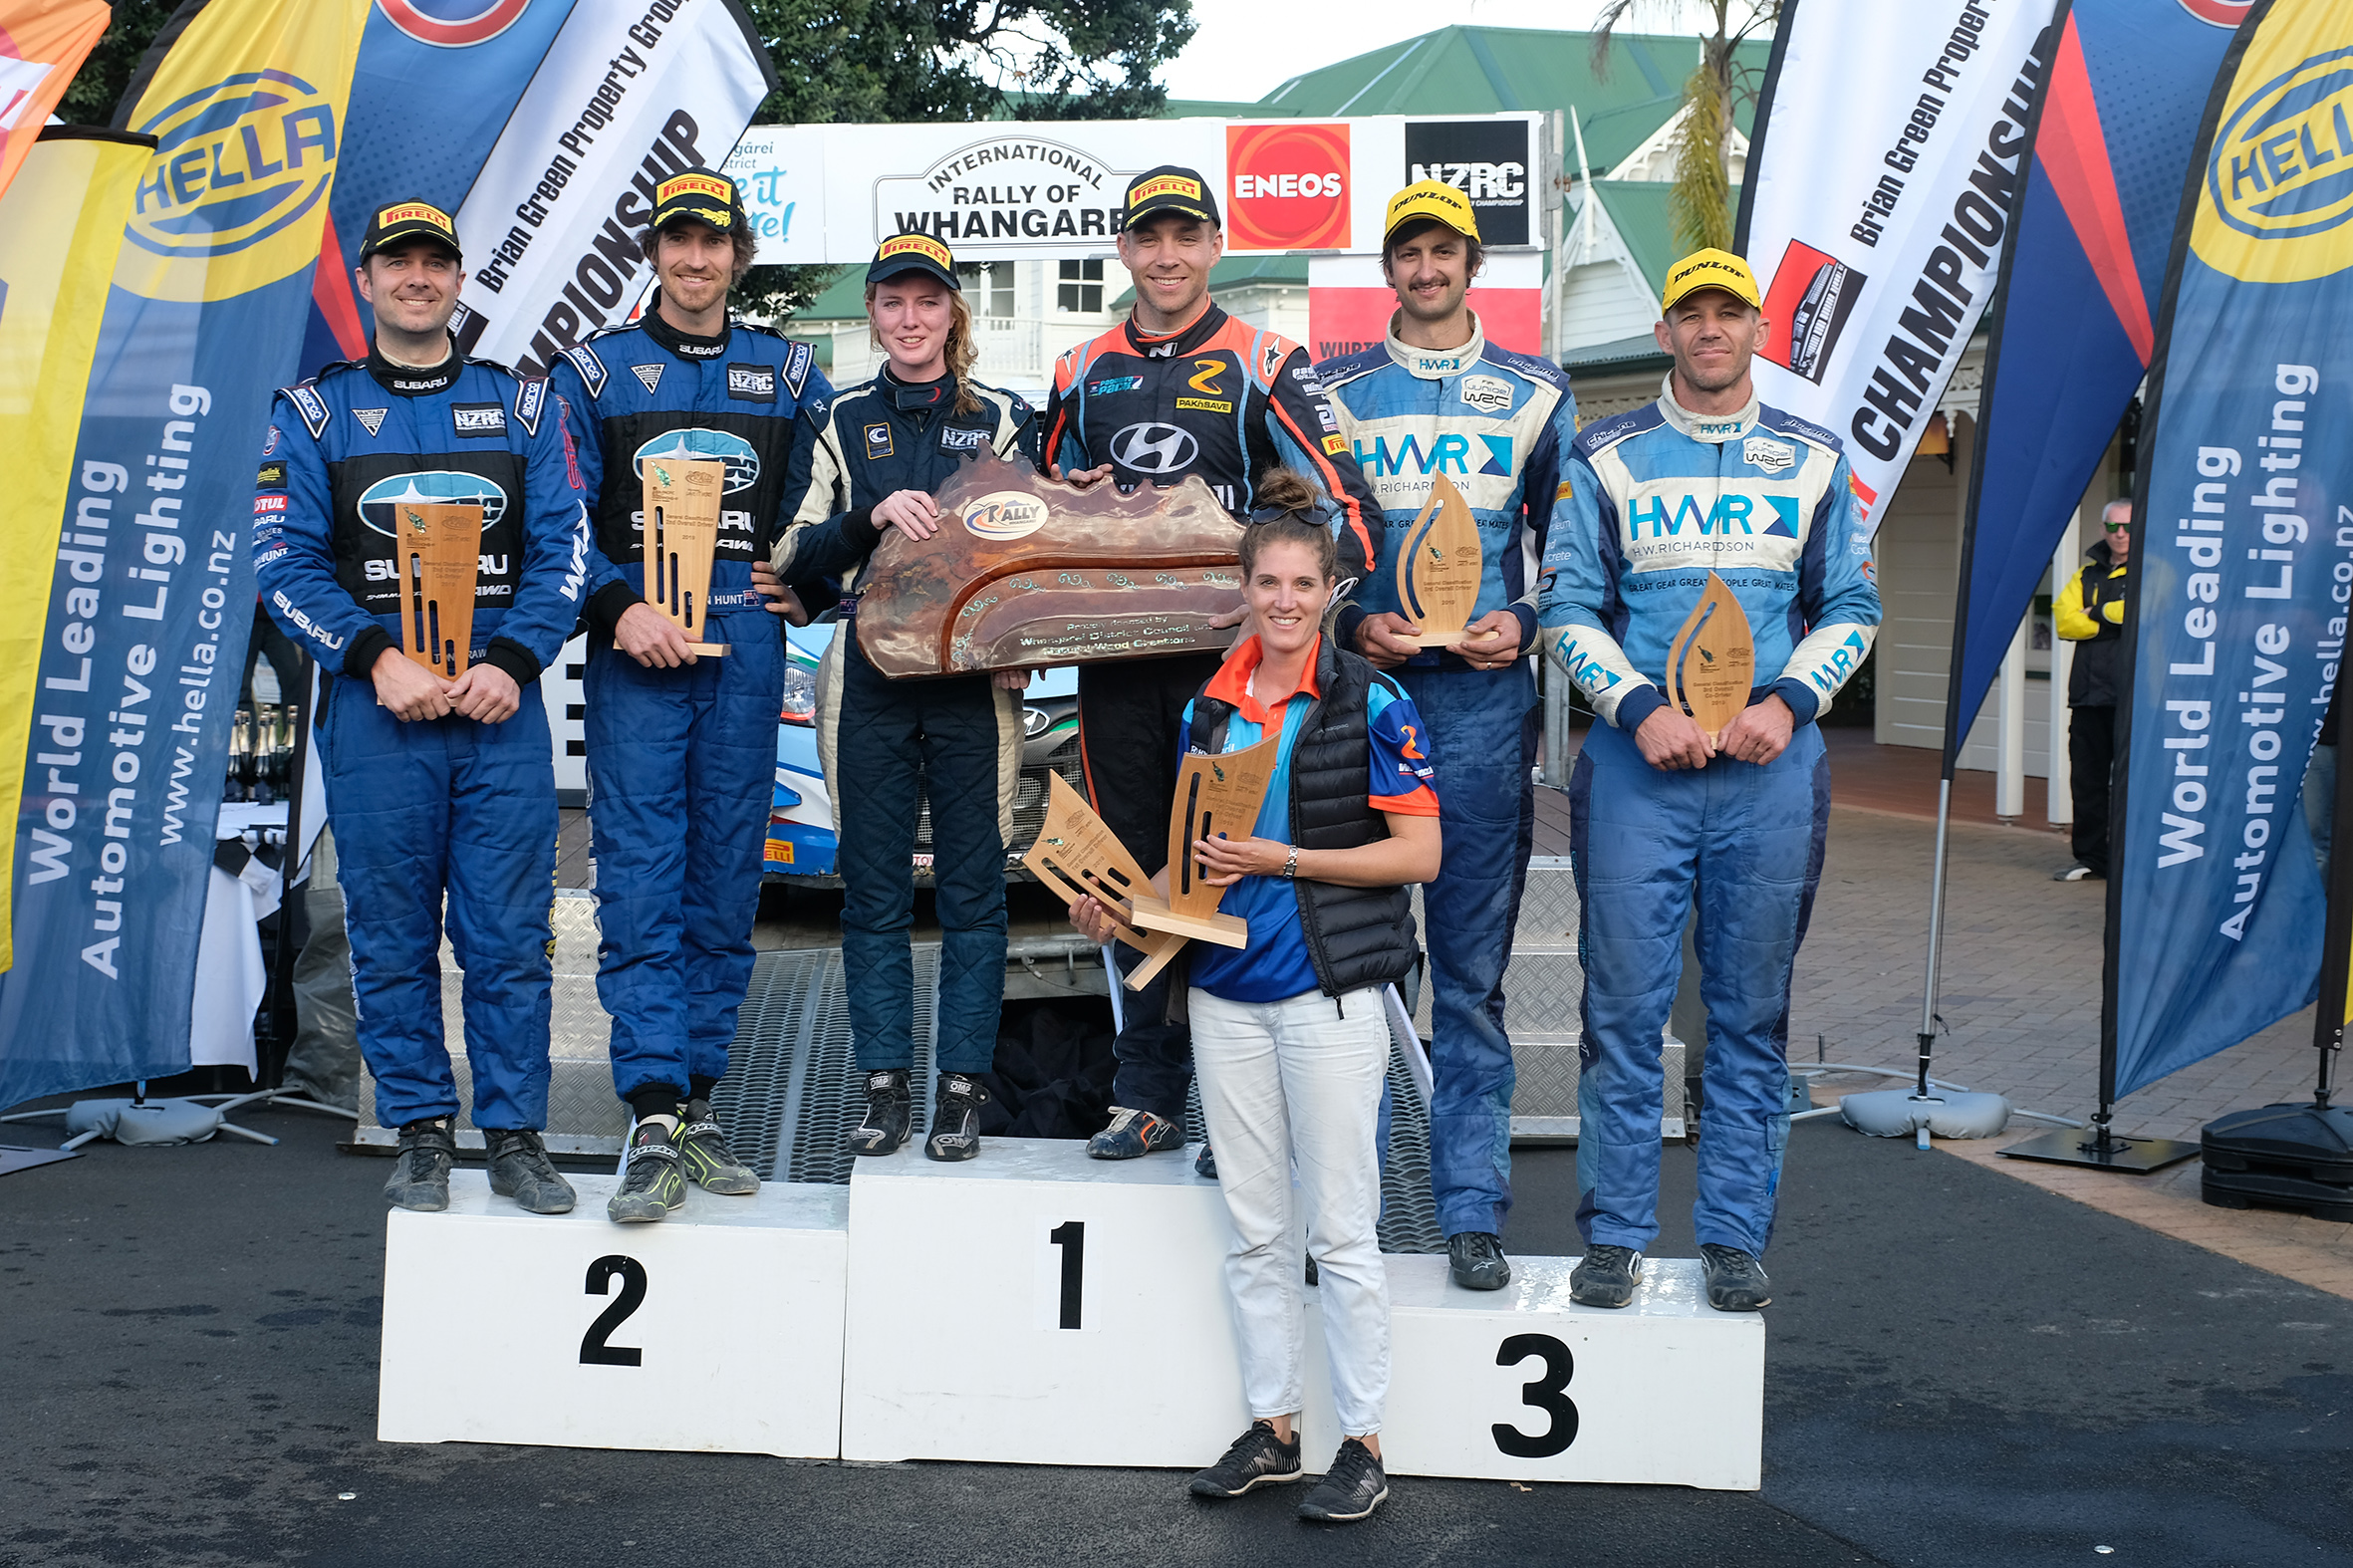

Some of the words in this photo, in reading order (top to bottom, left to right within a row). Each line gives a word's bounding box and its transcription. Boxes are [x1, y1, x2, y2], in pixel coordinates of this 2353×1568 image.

[1850, 174, 1905, 248] Brian
[1884, 93, 1946, 173] Green
[1922, 0, 1989, 94] Proper
[134, 103, 337, 215] HELLA
[475, 225, 533, 294] Brian
[516, 150, 577, 227] Green
[559, 46, 647, 157] Property
[629, 0, 689, 49] Grou
[734, 141, 773, 157] gārei
[2231, 102, 2353, 201] HELL
[723, 157, 757, 169] strict
[927, 144, 1103, 194] INTERNATIONAL
[662, 177, 725, 198] PIRELLI
[752, 165, 787, 207] it
[1134, 177, 1196, 201] PIRELLI
[1235, 172, 1343, 198] ENEOS
[1412, 161, 1524, 198] NZRC
[953, 185, 1037, 205] RALLY
[1046, 184, 1081, 204] OF
[1393, 191, 1462, 214] DUNLOP
[386, 206, 447, 229] PIRELLI
[752, 201, 796, 242] re!
[894, 208, 1124, 238] WHANGARE
[883, 240, 947, 265] PIRELLI
[1674, 261, 1745, 286] DUNLOP
[679, 344, 724, 356] SUBARU
[790, 345, 808, 381] sparco
[1420, 359, 1449, 370] HWR
[393, 376, 448, 391] SUBARU
[728, 373, 774, 392] NZRC
[1464, 392, 1509, 407] WRC
[454, 410, 505, 426] NZRC
[1700, 422, 1733, 434] HWR
[1354, 433, 1469, 477] HWR
[1746, 453, 1792, 466] WRC
[2244, 364, 2320, 600] Lighting
[254, 497, 285, 512] OTUL
[1628, 494, 1753, 541] HWR
[1488, 520, 1509, 530] MATES
[364, 554, 508, 582] SURU
[2169, 446, 2242, 676] Leading
[45, 459, 130, 692] Leading
[1629, 582, 1653, 592] GREAT
[1656, 579, 1676, 590] GEAR
[1751, 579, 1771, 588] GREAT
[1774, 581, 1795, 592] MATES
[714, 594, 743, 605] HUNT
[272, 590, 345, 650] SUBARU
[81, 644, 156, 980] Automotive
[123, 384, 212, 622] Lighting
[159, 530, 236, 847] www.hella.co.nz
[2157, 700, 2212, 869] World
[2220, 623, 2290, 942] Automotive
[29, 713, 86, 886] World
[764, 846, 790, 862] ELLI
[870, 1078, 889, 1088] OMP
[949, 1082, 971, 1093] OMP
[1050, 1220, 1085, 1330] 1
[579, 1254, 648, 1367] 2
[1491, 1333, 1579, 1458] 3
